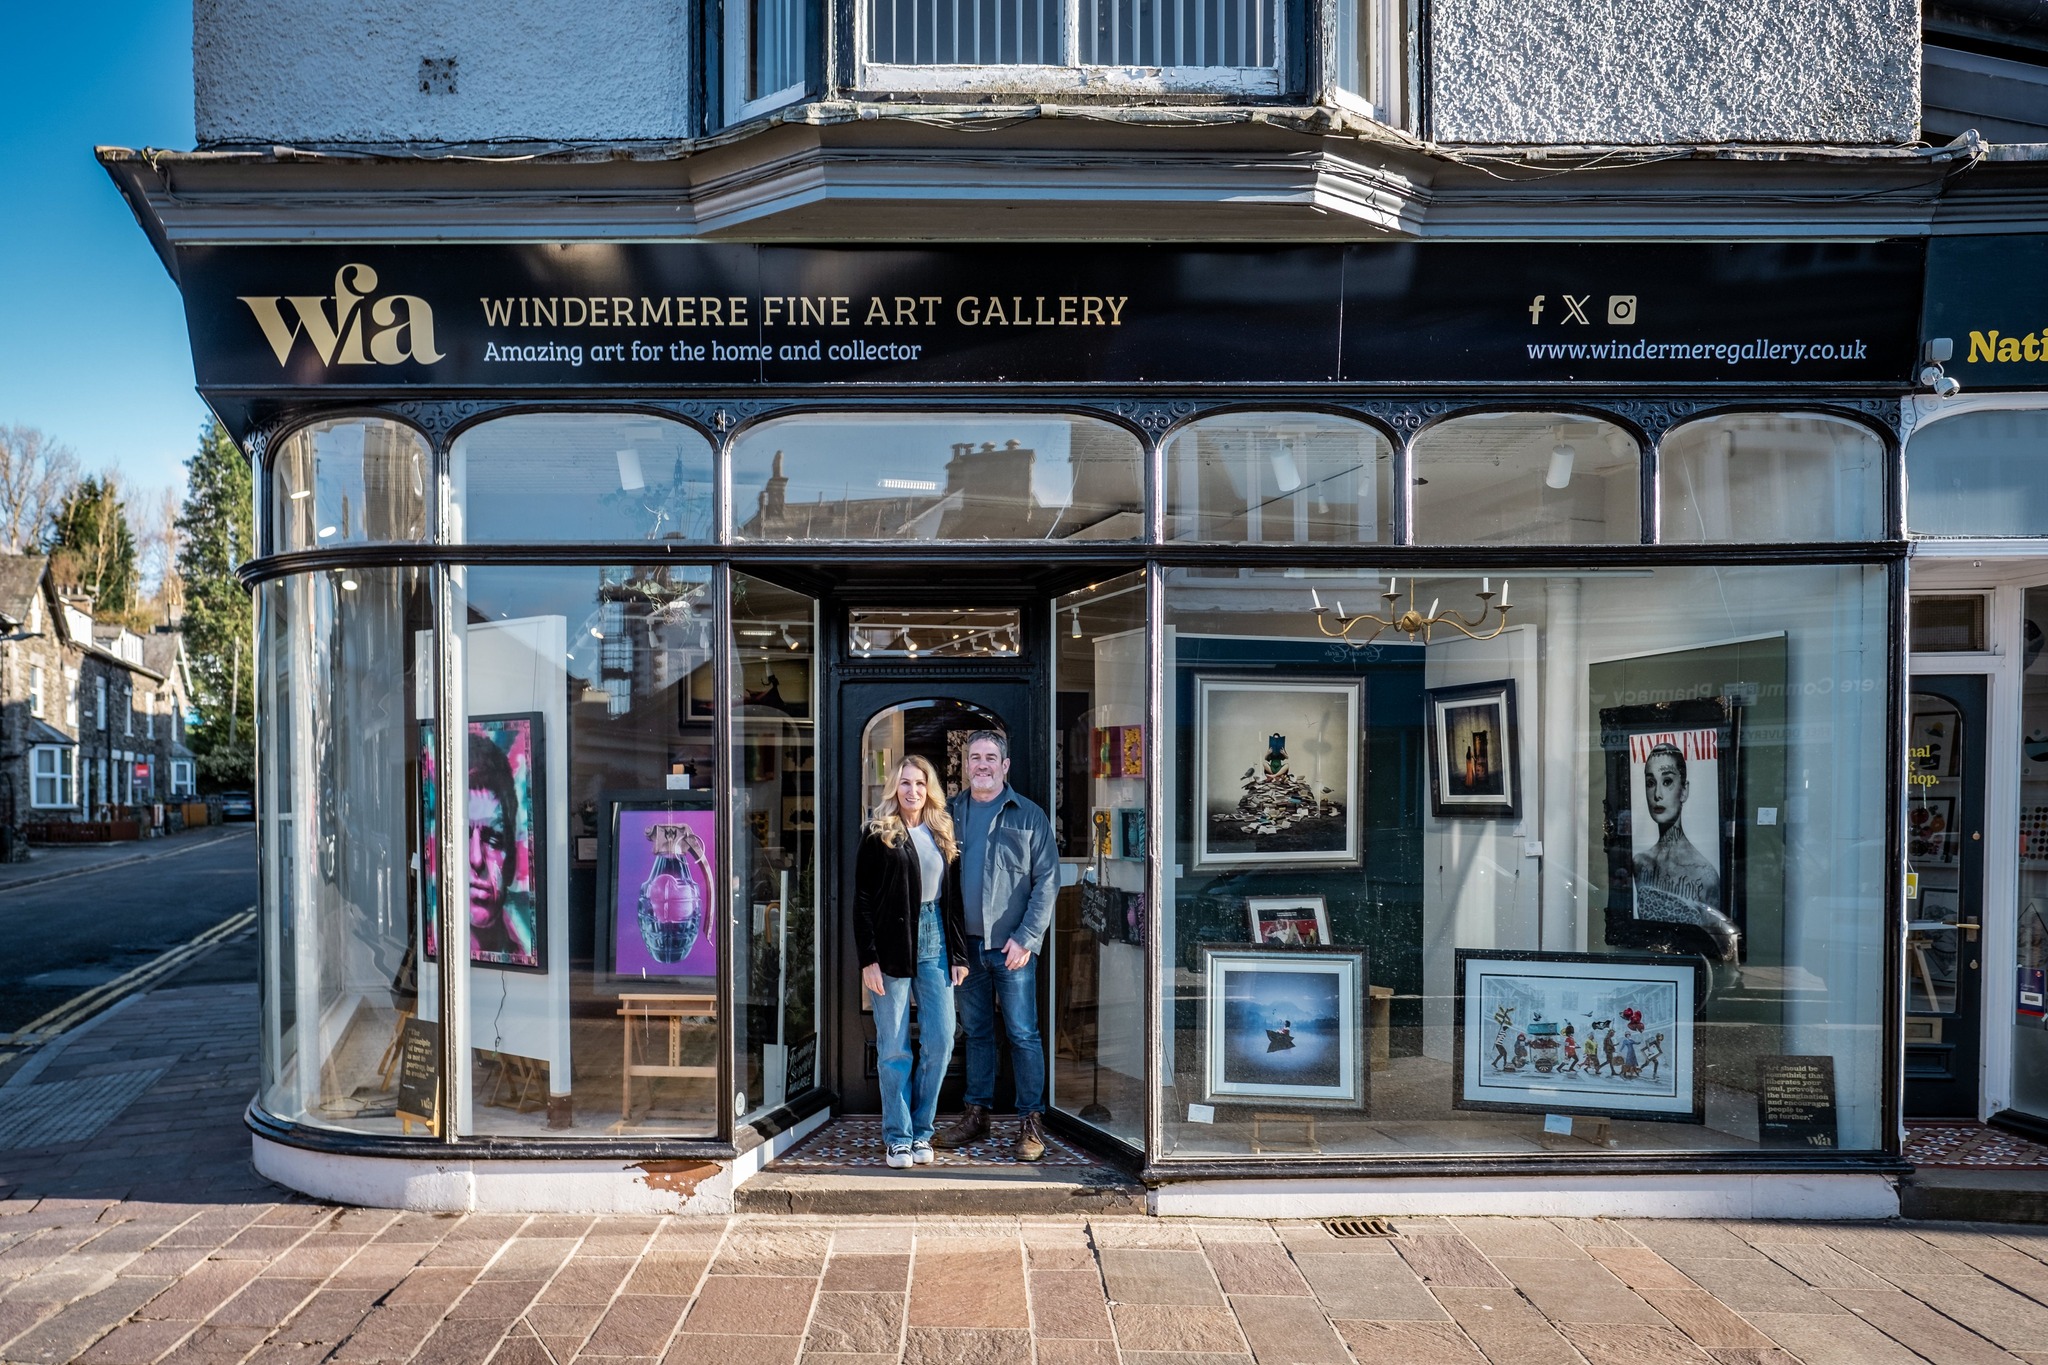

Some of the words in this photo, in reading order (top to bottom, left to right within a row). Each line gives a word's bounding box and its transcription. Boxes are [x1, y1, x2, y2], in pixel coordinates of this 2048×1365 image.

[236, 263, 446, 368] wfa
[480, 297, 748, 326] WINDERMERE
[763, 297, 850, 326] FINE
[864, 297, 942, 326] ART
[956, 296, 1128, 326] GALLERY
[483, 341, 583, 366] Amazing
[589, 343, 625, 361] art
[630, 341, 663, 361] for
[670, 341, 706, 361] the
[711, 341, 773, 361] home
[779, 342, 822, 361] and
[827, 341, 922, 361] collector
[1526, 340, 1867, 364] www.windermeregallery.co.uk
[1967, 328, 2048, 363] Nati
[1683, 730, 1719, 761] FAIR
[1784, 1100, 1830, 1108] encourages
